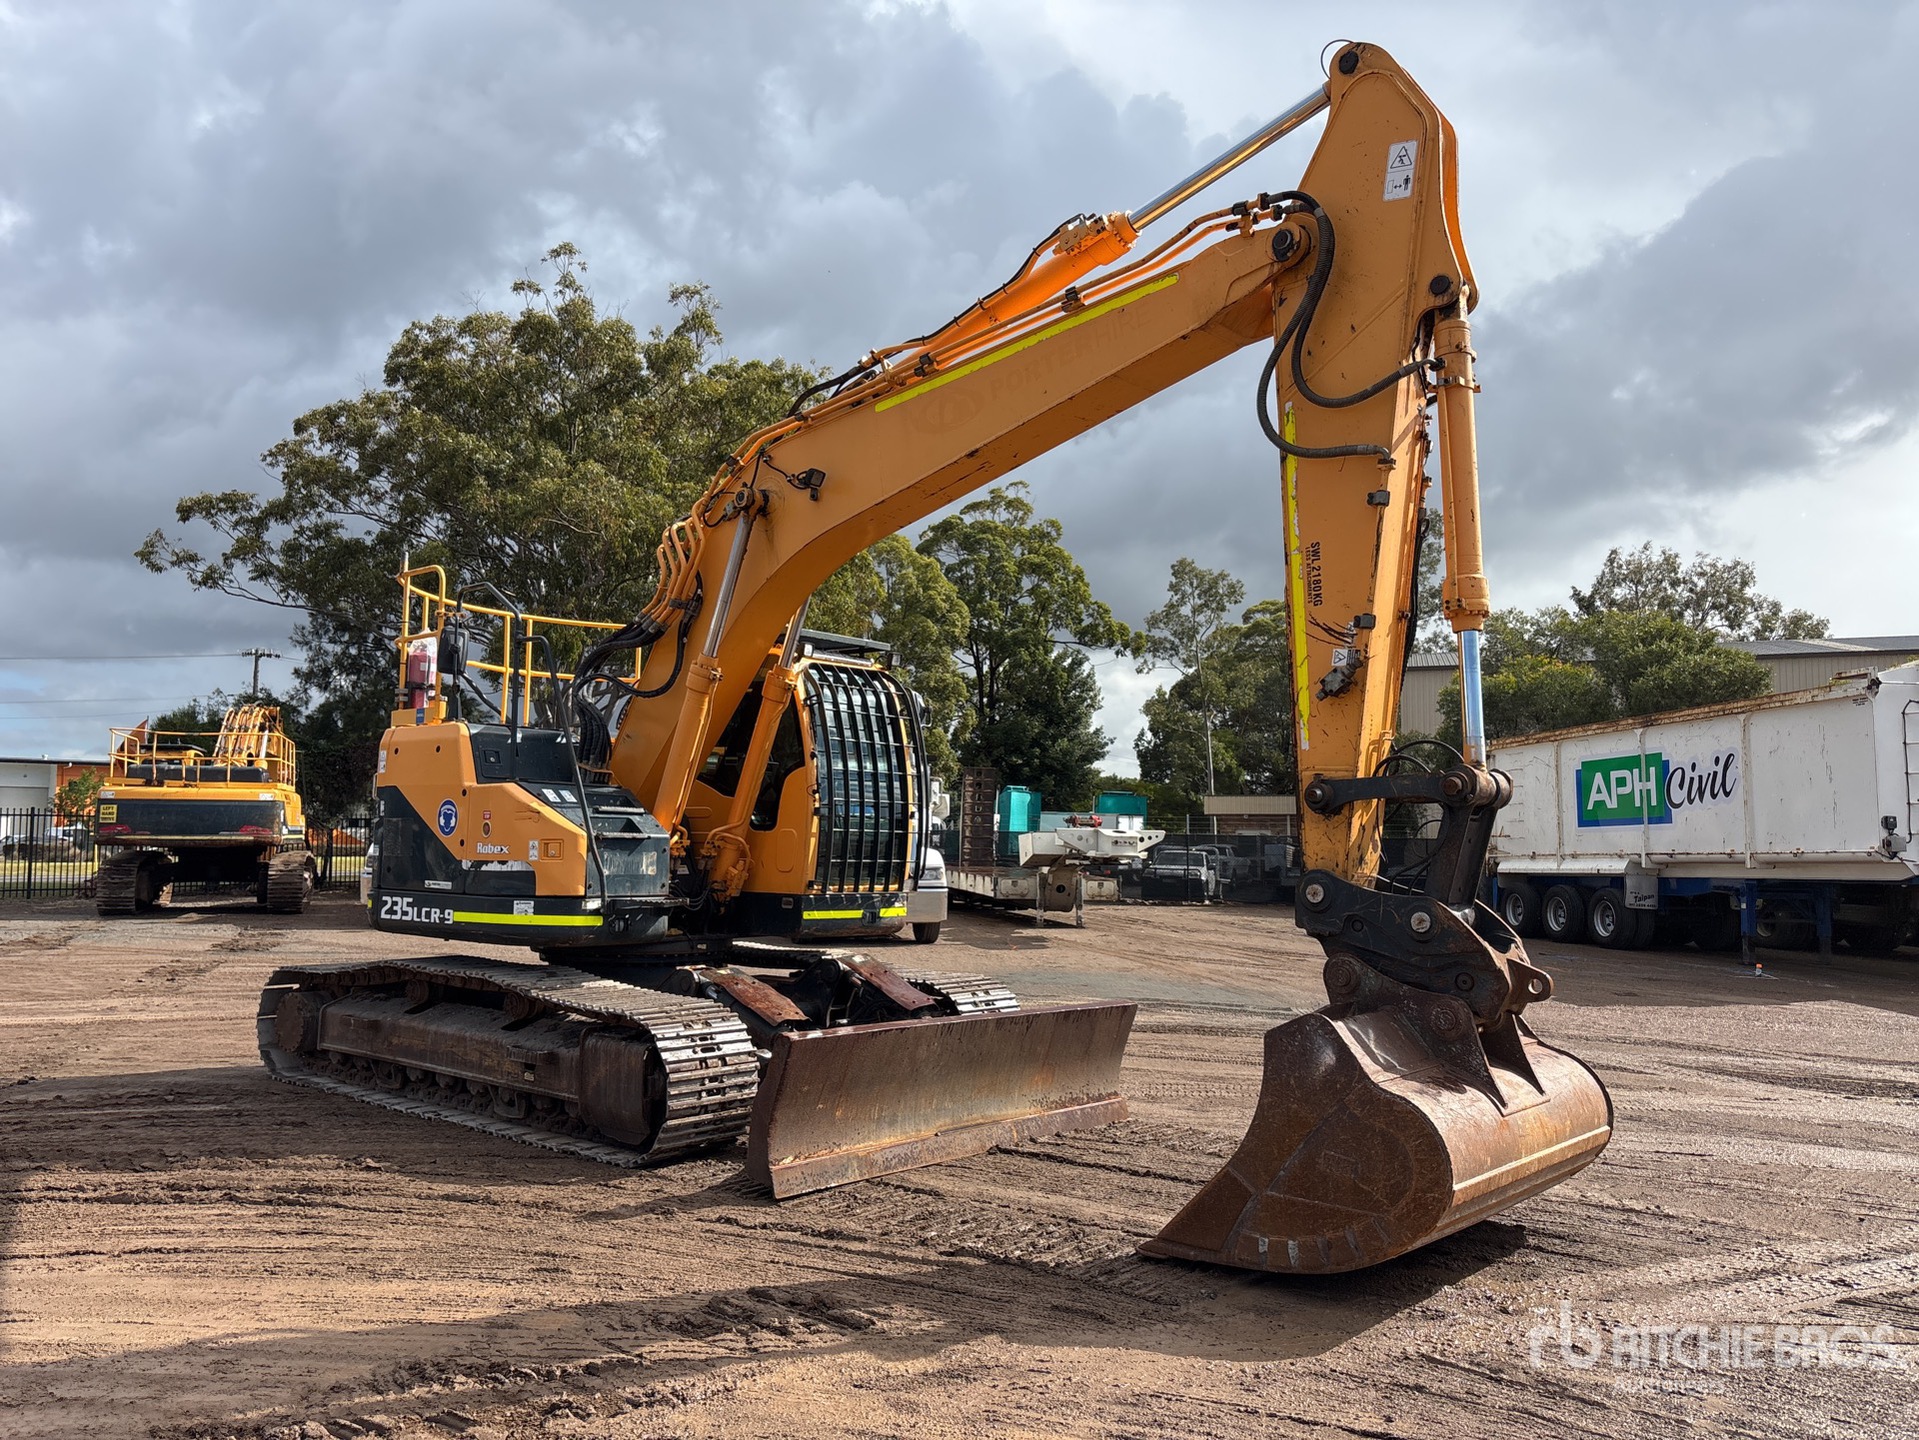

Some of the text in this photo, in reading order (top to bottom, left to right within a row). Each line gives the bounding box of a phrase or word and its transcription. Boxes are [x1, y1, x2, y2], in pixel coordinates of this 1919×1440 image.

[1311, 542, 1323, 607] SWL 2180KG
[1587, 753, 1737, 810] APH Civil
[477, 842, 510, 854] Robex
[380, 896, 454, 925] 235LCR-9
